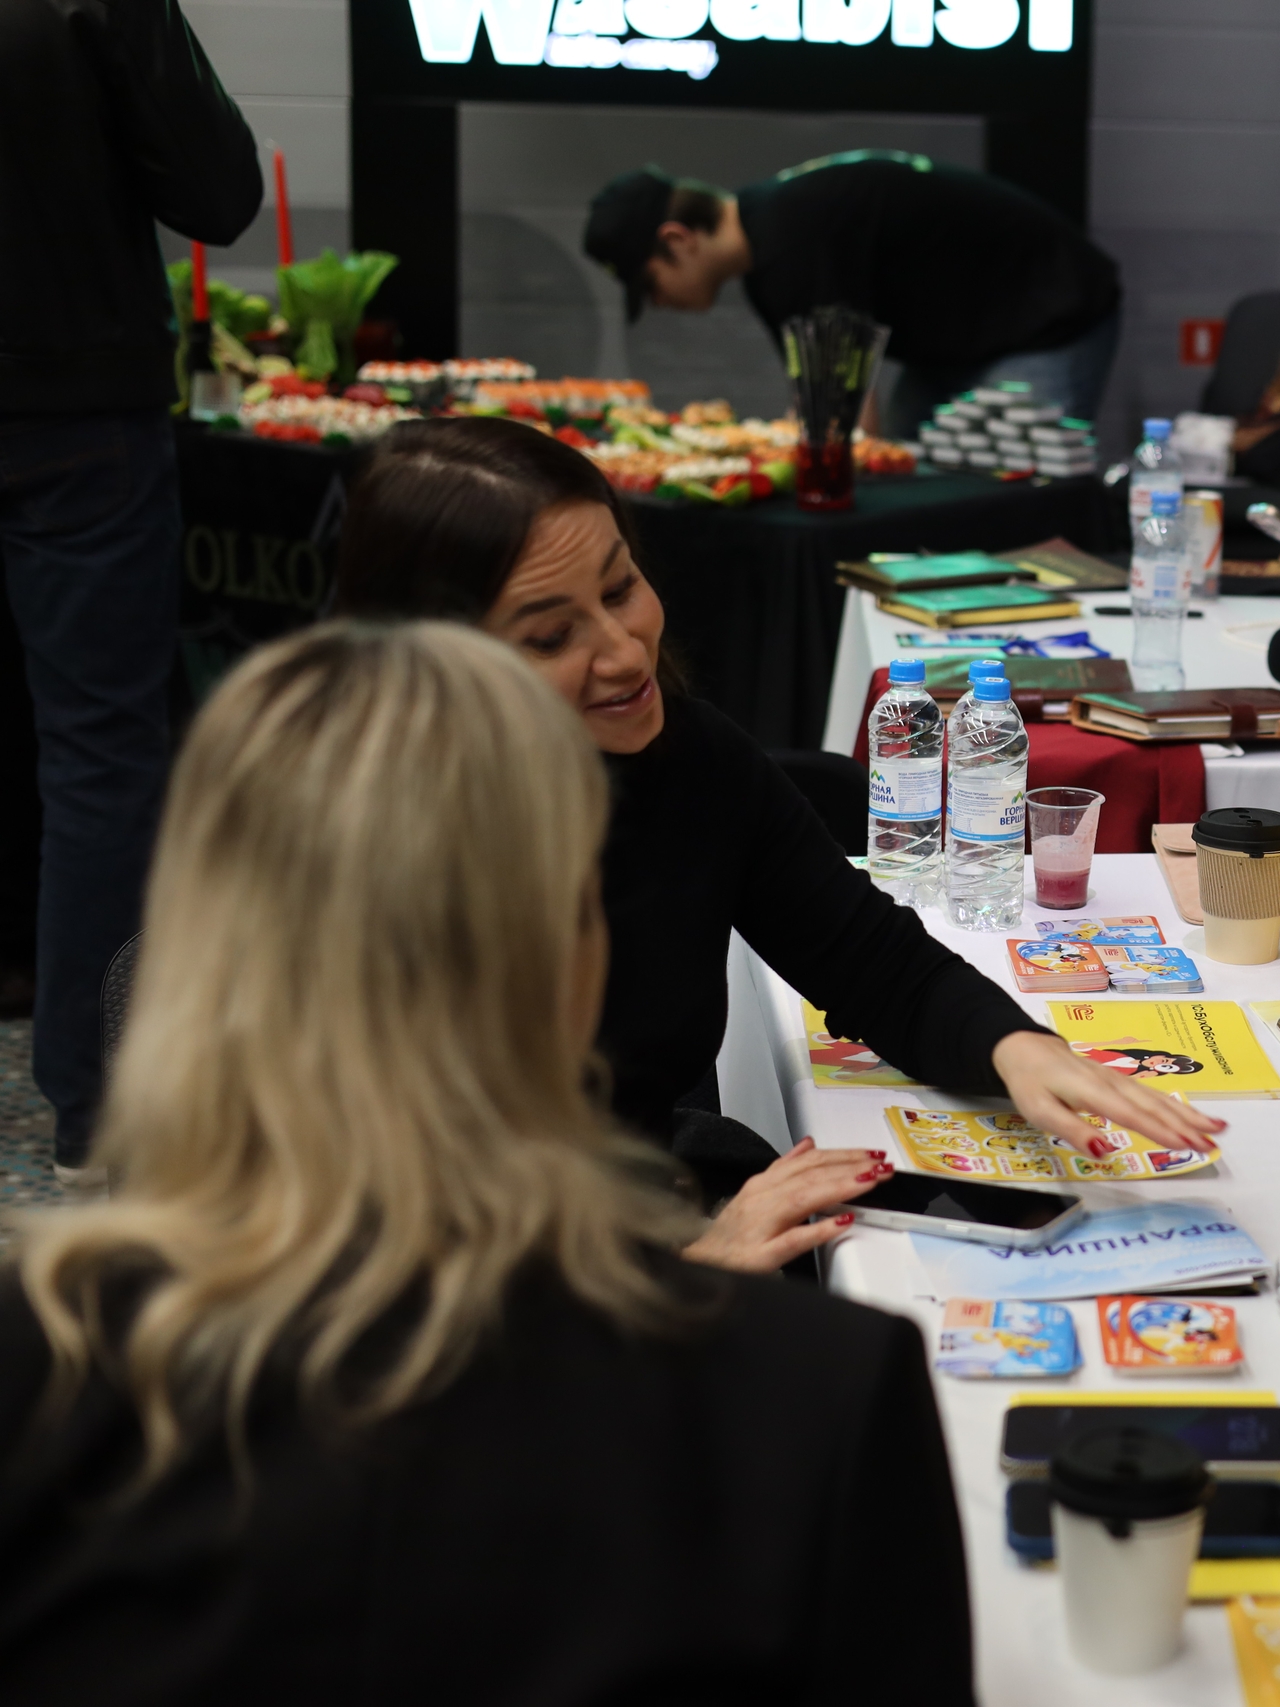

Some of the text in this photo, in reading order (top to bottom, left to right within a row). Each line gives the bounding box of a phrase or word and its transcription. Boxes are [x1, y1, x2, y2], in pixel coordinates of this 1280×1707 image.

[869, 783, 892, 796] ОРНАЯ
[869, 791, 896, 805] РШИНА
[987, 1220, 1237, 1260] ФРАНШИЗА
